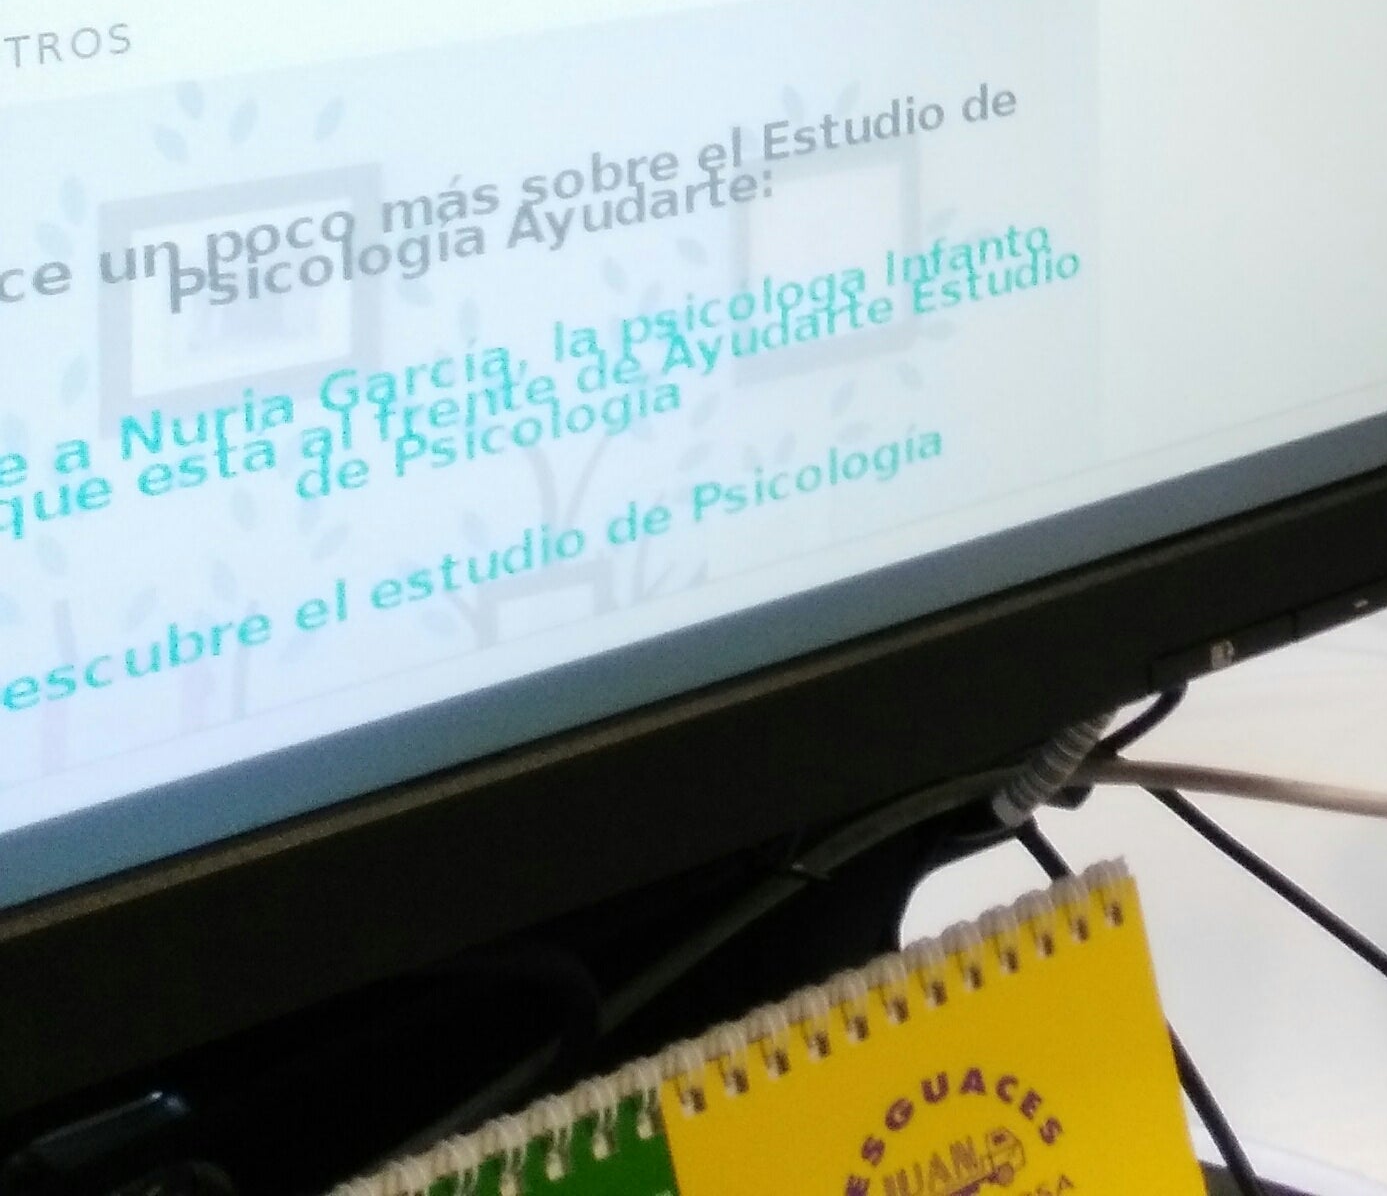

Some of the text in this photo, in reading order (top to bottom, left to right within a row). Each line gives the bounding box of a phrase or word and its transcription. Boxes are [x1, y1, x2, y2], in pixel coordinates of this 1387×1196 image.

[4, 23, 133, 69] TROS
[100, 240, 179, 285] un
[207, 210, 354, 291] poco
[382, 174, 499, 233] más
[521, 151, 679, 208] sobre
[698, 126, 742, 173] el
[763, 96, 945, 162] Estudio
[962, 82, 1017, 123] de
[507, 170, 773, 251] Ayudarte:
[0, 476, 113, 539] que
[301, 407, 352, 459] al
[374, 371, 556, 442] frente
[576, 347, 641, 394] de
[662, 289, 893, 377] Ayudarte
[913, 246, 1080, 315] Estudio
[53, 437, 91, 475] a
[119, 386, 295, 460] Nuria
[554, 321, 598, 363] la
[886, 223, 1050, 287] Infanto
[2, 422, 943, 712] escubre el estudio de Psicología
[296, 448, 369, 500] de
